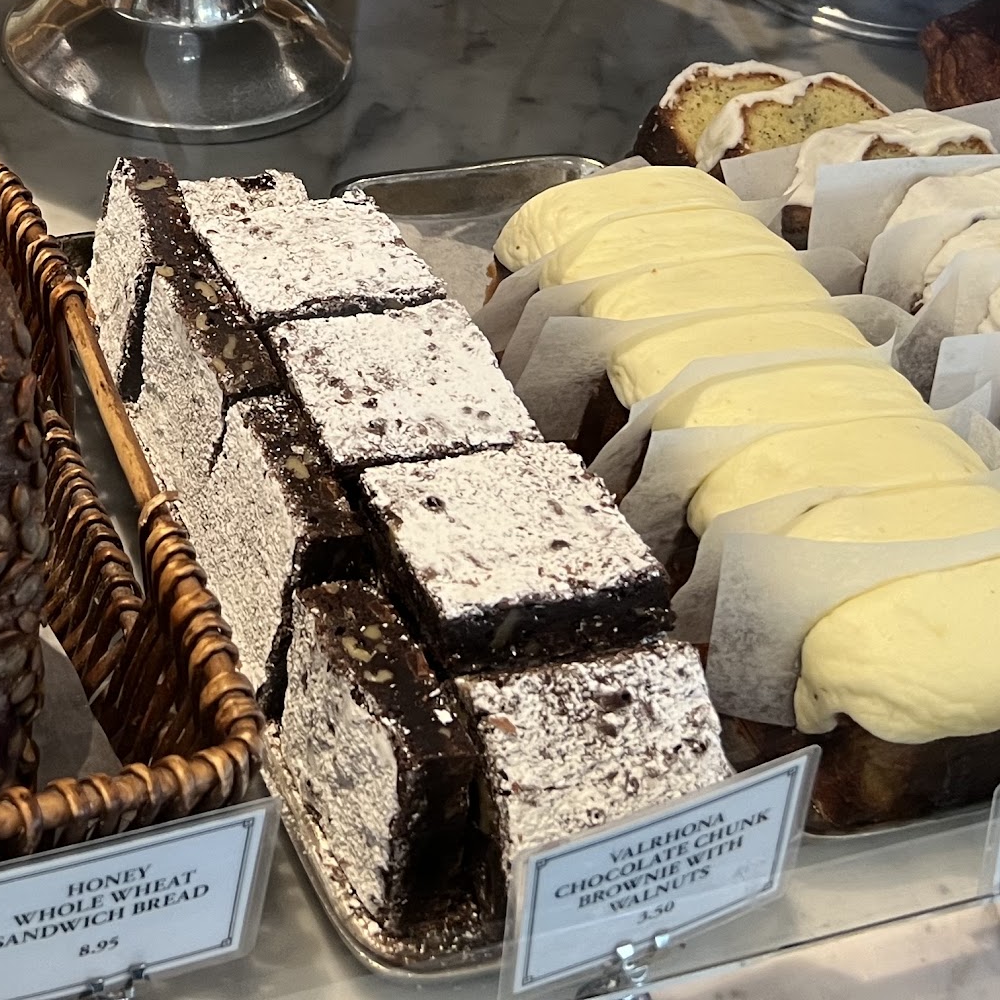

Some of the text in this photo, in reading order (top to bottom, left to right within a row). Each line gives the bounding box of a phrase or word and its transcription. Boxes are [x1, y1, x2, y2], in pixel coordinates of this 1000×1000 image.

[554, 808, 770, 899] CHOCOLATE CHUNK
[609, 812, 724, 863] VALRHONA
[67, 864, 152, 897] HONEY
[577, 836, 744, 908] BROWNIE WITH
[609, 865, 711, 912] WALNUTS
[13, 869, 197, 927] WHOLE WHEAT
[132, 884, 210, 916] BREAD
[637, 900, 675, 924] 3.50
[79, 936, 119, 957] 8.95
